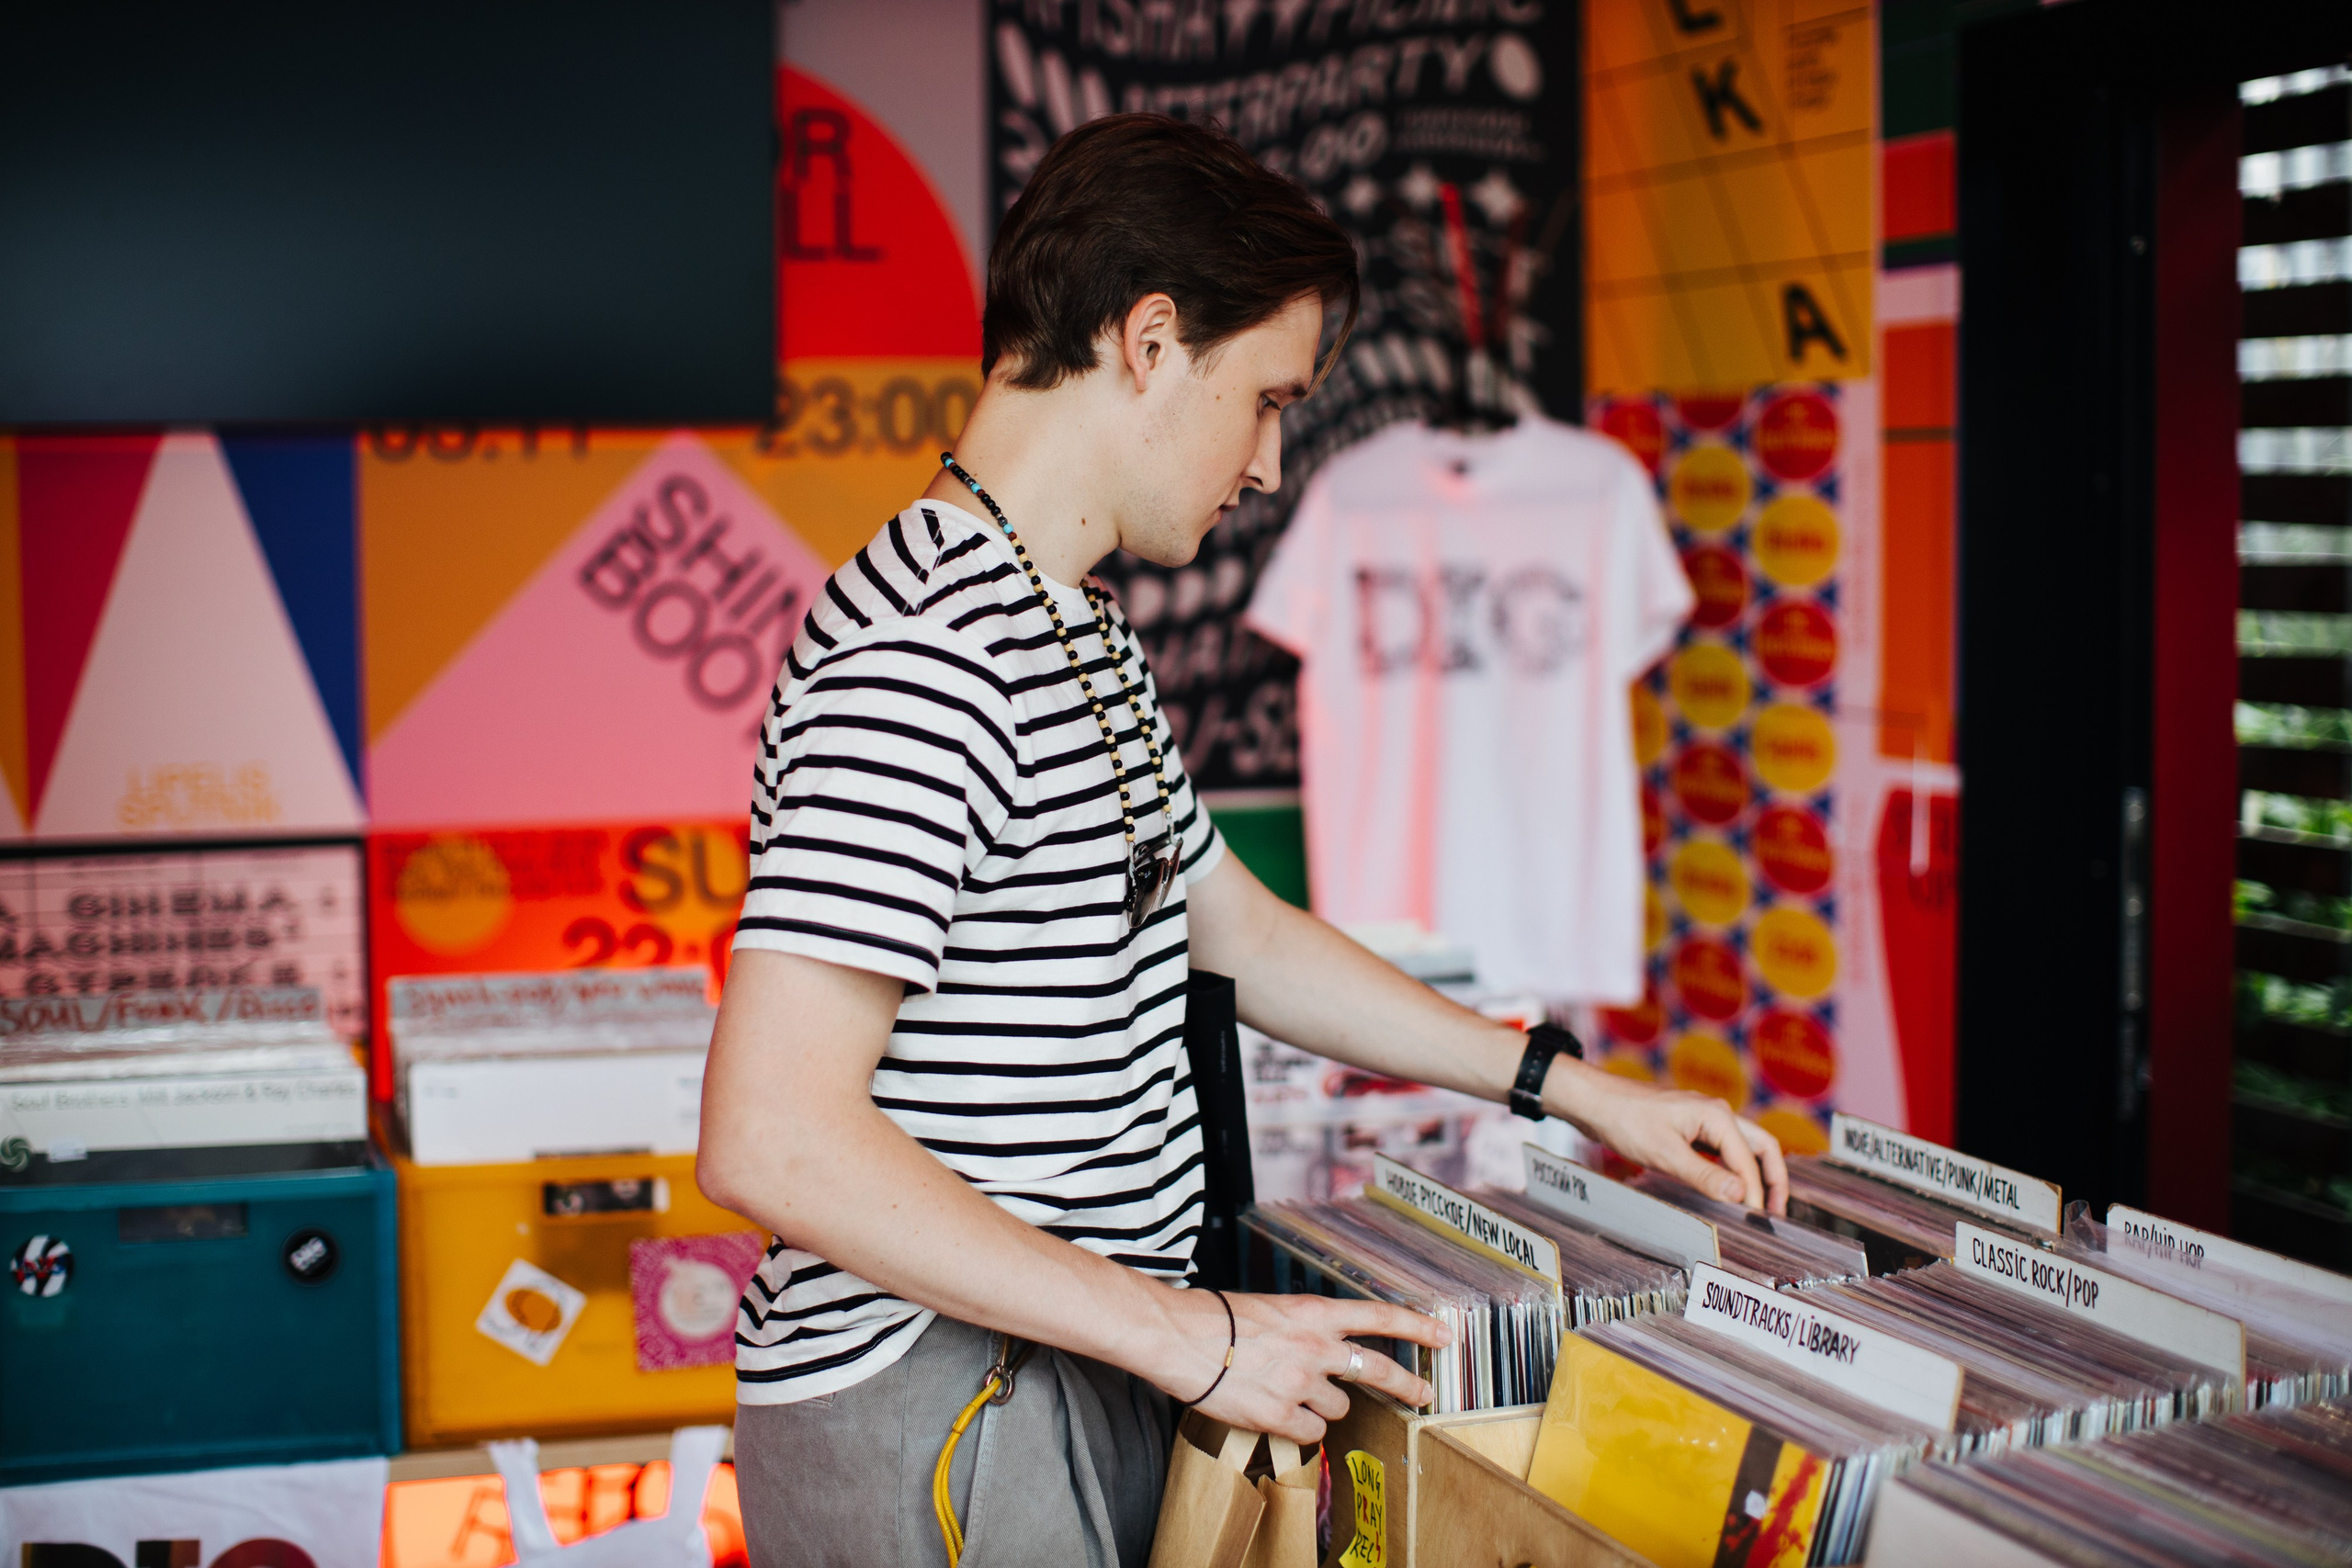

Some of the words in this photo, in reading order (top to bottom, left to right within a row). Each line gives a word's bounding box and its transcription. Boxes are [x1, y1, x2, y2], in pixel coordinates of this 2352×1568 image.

[1781, 281, 1849, 364] A
[1502, 1227, 1540, 1271] LOCAL
[2179, 1238, 2205, 1270] HOP
[1973, 1237, 2028, 1283] CLASSIC
[2031, 1258, 2099, 1309] ROCK/POP
[1702, 1281, 1861, 1365] SOUNDTRACKS/LIBRARY
[1351, 1457, 1381, 1501] LONG
[1357, 1492, 1383, 1537] PRAY
